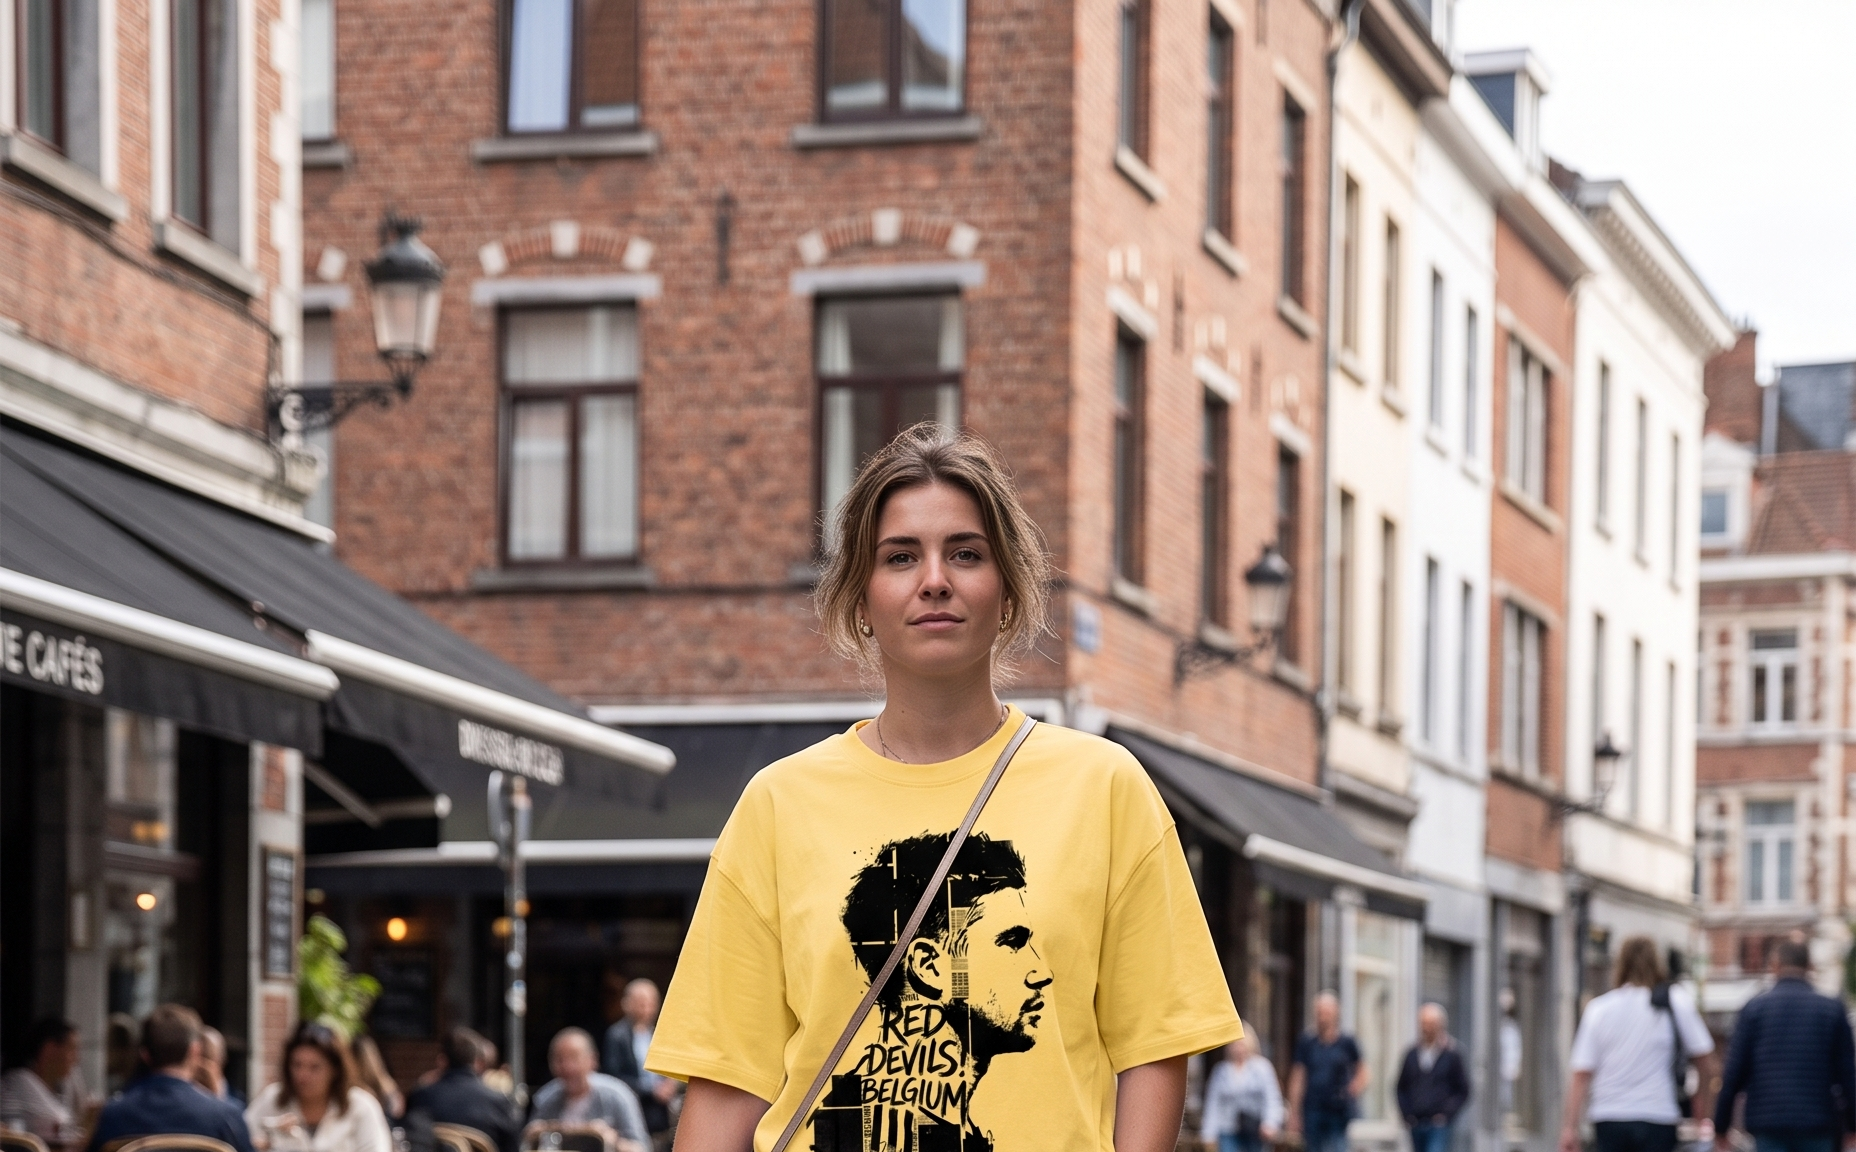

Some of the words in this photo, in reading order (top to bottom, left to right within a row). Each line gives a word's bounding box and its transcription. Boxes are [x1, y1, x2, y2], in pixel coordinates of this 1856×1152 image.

[25, 630, 104, 695] CAFÉS
[879, 1003, 946, 1046] RED
[861, 1076, 969, 1122] BELGIUM
